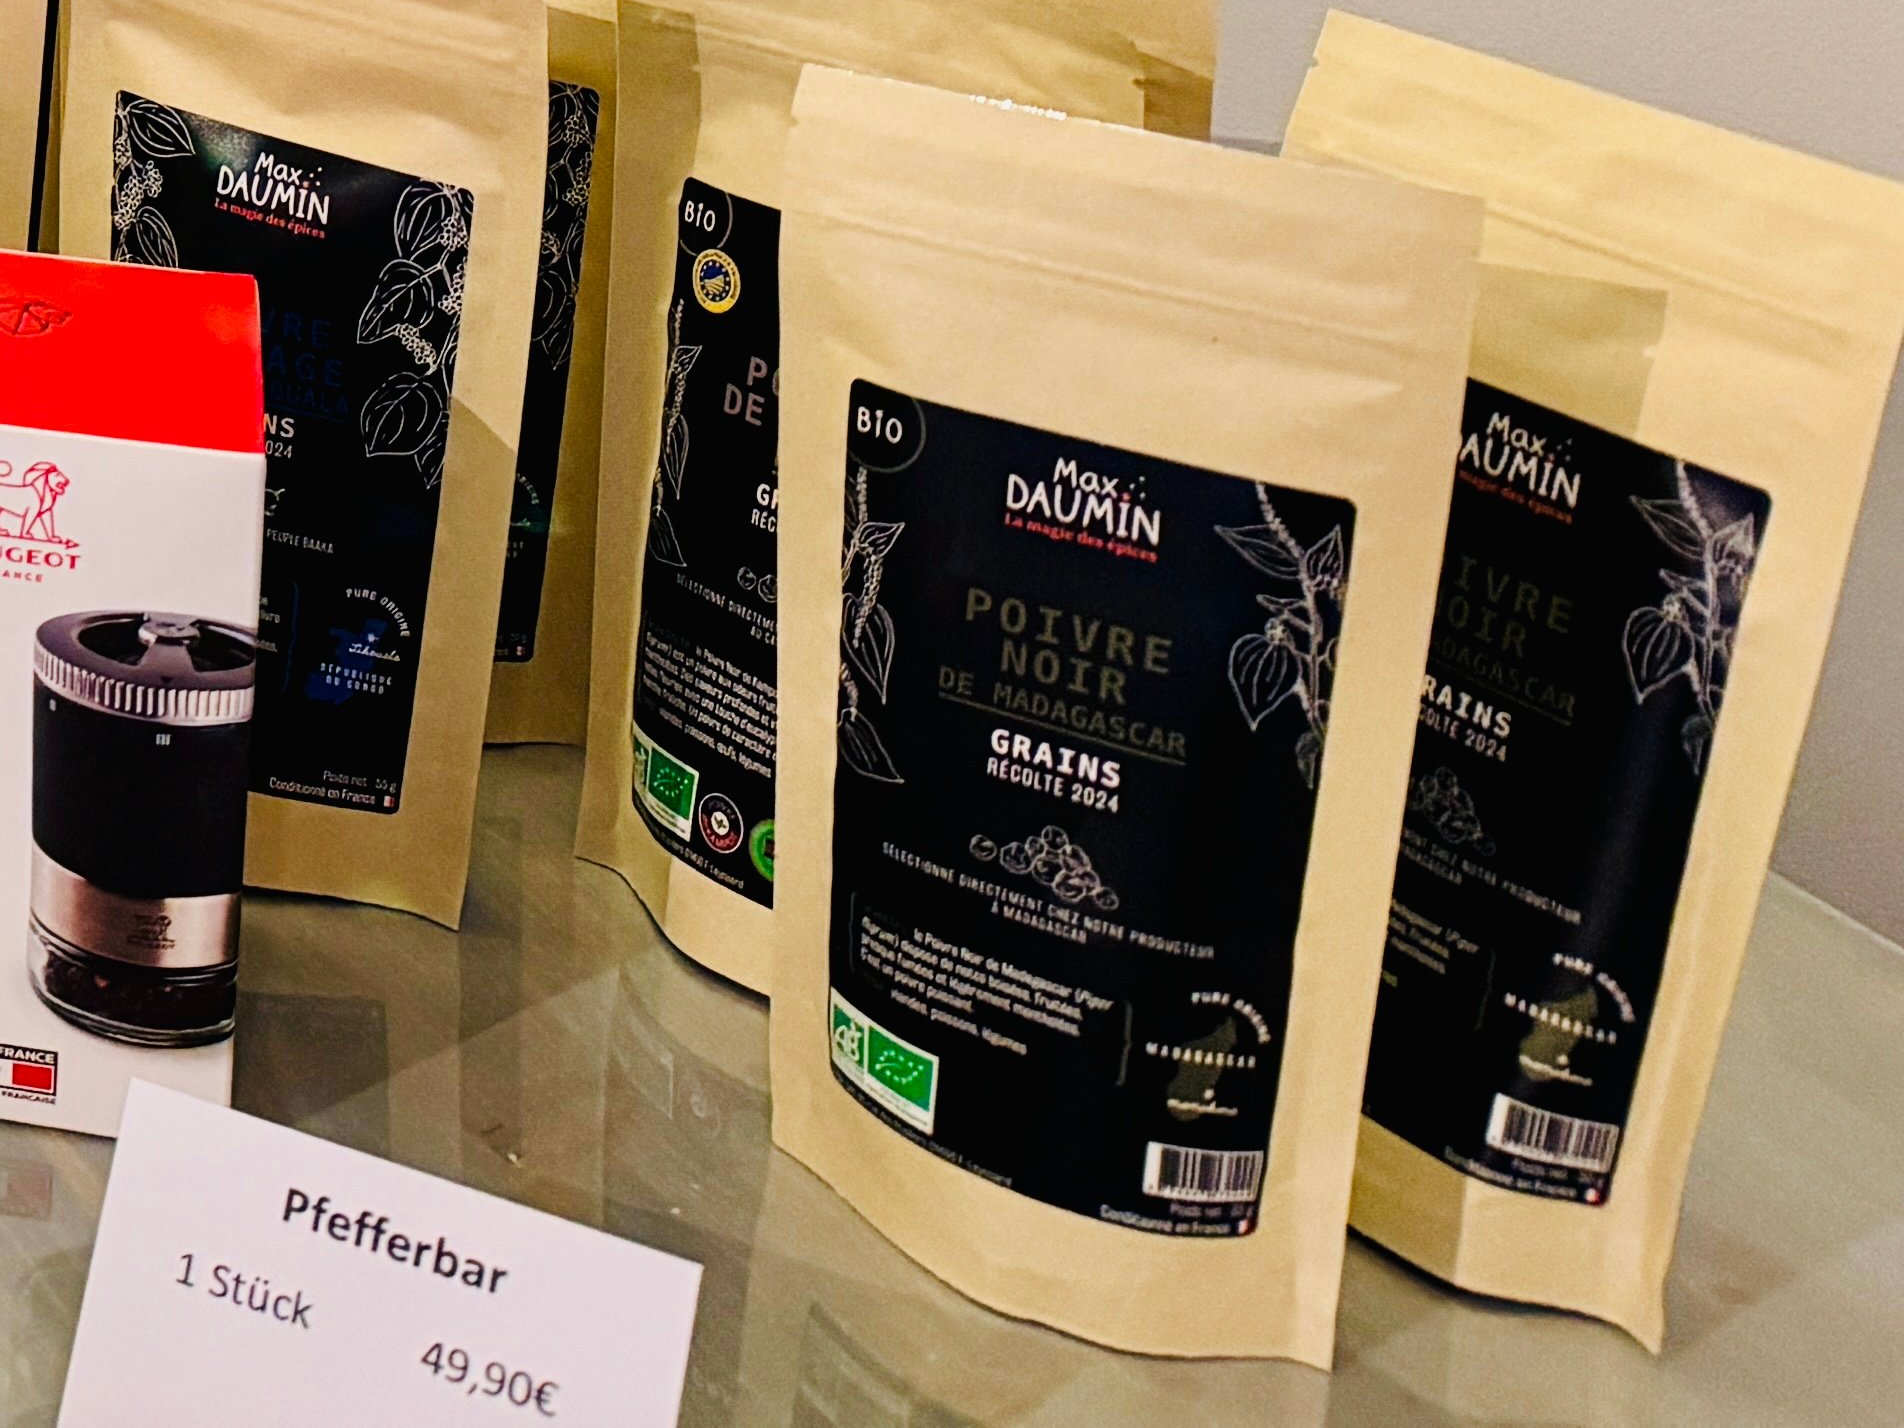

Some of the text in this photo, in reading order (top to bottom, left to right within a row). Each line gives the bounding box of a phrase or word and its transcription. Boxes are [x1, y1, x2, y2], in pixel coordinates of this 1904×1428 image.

[216, 164, 330, 225] DAUMIN
[253, 151, 302, 186] Max
[214, 197, 326, 239] La magie des épices
[684, 199, 716, 233] BIO
[724, 382, 765, 427] DE
[856, 405, 903, 444] BIO
[1486, 411, 1547, 455] Max
[264, 439, 293, 460] 024
[1053, 456, 1119, 497] Max
[1459, 431, 1581, 509] AUMIN
[1004, 511, 1158, 564] La magie des épices
[1006, 473, 1161, 546] DAUMIN
[346, 588, 411, 638] PURE ORIGINE
[1453, 554, 1575, 635] IVRE
[965, 587, 1174, 675] POIVRE
[1436, 593, 1528, 660] OIR
[999, 638, 1127, 706] NOIR
[938, 664, 1187, 757] DE MADAGASCAR
[1422, 674, 1512, 740] RAINS
[990, 728, 1122, 789] GRAINS
[1464, 727, 1507, 763] 2024
[987, 756, 1120, 814] RÉCOLTE 2024
[282, 1187, 509, 1295] Pfefferbar
[175, 1253, 313, 1330] 1 Stück
[420, 1341, 559, 1419] 49,90€
